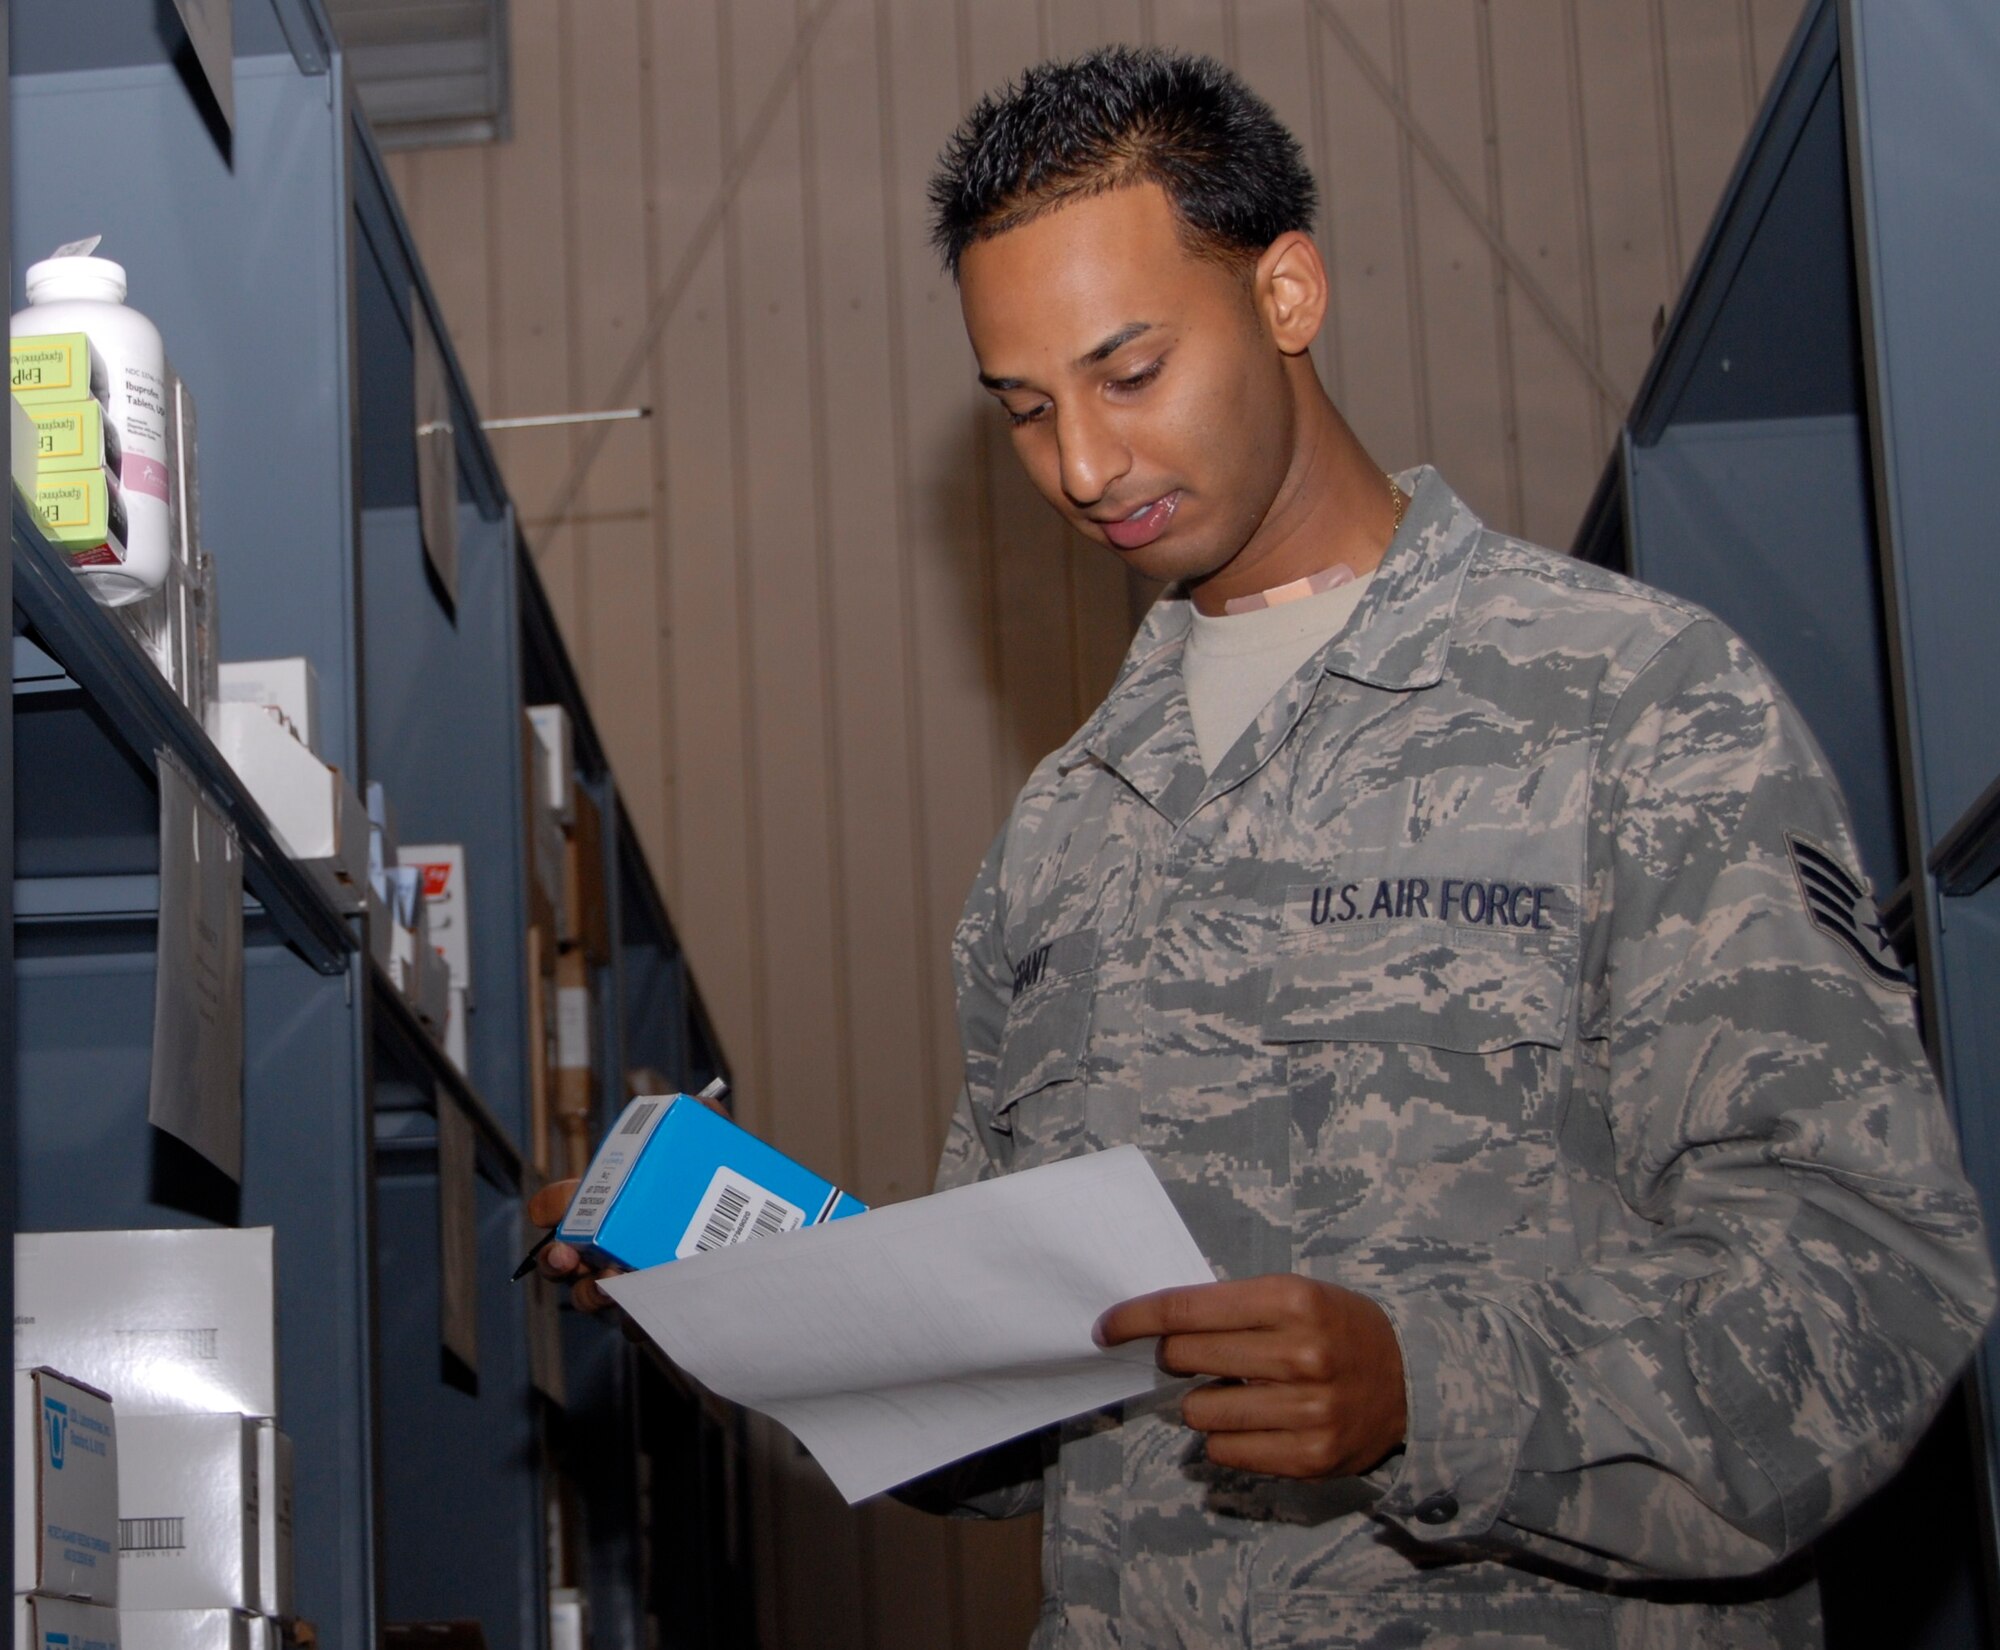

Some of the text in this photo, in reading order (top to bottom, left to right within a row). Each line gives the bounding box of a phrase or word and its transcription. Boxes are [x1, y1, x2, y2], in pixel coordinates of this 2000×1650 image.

[1310, 878, 1555, 930] U.S. AIR FORCE
